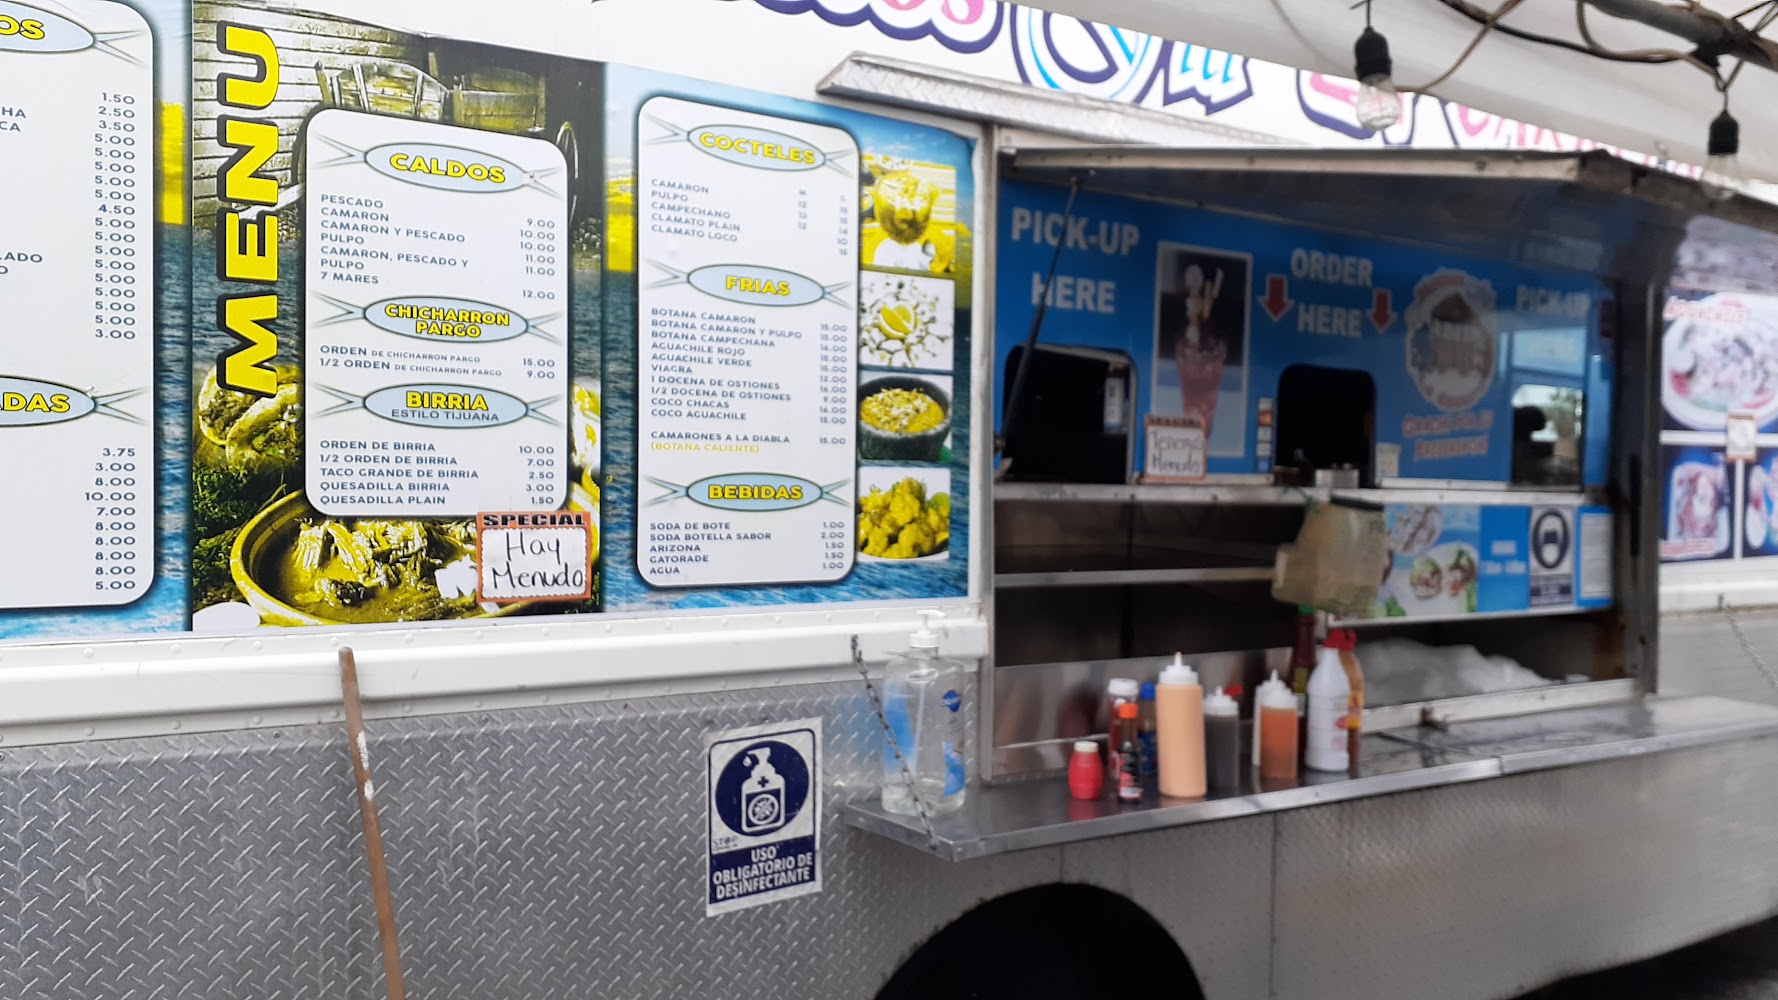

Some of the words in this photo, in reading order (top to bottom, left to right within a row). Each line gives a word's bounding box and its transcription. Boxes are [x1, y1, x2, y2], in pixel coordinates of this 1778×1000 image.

[102, 92, 135, 105] 1.50
[98, 106, 135, 118] 2.50
[98, 120, 135, 132] 3.50
[95, 133, 135, 146] 5.00
[95, 147, 135, 160] 5.00
[699, 132, 815, 165] COCTELES
[95, 161, 135, 174] 5.00
[389, 152, 506, 184] CALDOS
[95, 175, 135, 188] 5.00
[651, 179, 709, 194] CAMARON
[95, 189, 135, 201] 5.00
[651, 190, 688, 202] PULPO
[321, 194, 383, 209] PESCADO
[98, 204, 135, 215] 4.50
[216, 20, 279, 398] MENU
[321, 207, 389, 222] CAMARON
[651, 201, 731, 219] CAMPECHANO
[95, 217, 135, 229] 5.00
[527, 218, 555, 229] 9.00
[651, 213, 705, 227] CLAMATO
[708, 220, 740, 232] PLAIN
[95, 231, 135, 243] 5.00
[321, 220, 389, 235] CAMARON
[394, 227, 401, 236] Y
[406, 229, 465, 242] PESCADO
[520, 229, 555, 241] 10.00
[651, 224, 705, 238] CLAMATO
[708, 232, 738, 242] LOCO
[1010, 207, 1140, 257] PICK-UP
[321, 233, 364, 245] PULPO
[95, 245, 135, 257] 5.00
[520, 241, 555, 252] 10.00
[95, 259, 135, 271] 5.00
[321, 258, 364, 270] PULPO
[397, 253, 457, 266] PESCADO
[461, 259, 468, 268] Y
[525, 254, 555, 264] 11.00
[526, 266, 555, 276] 11.00
[1290, 248, 1373, 288] ORDER
[95, 273, 135, 285] 5.00
[321, 271, 328, 279] 7
[333, 272, 378, 284] MARES
[725, 275, 791, 296] FRIAS
[95, 287, 135, 298] 5.00
[523, 289, 555, 300] 12.00
[1031, 272, 1116, 314] HERE
[95, 301, 135, 312] 5.00
[95, 315, 135, 326] 5.00
[384, 303, 510, 327] CHICHARRON
[651, 308, 697, 319] BOTANA
[701, 312, 756, 324] CAMARON
[1297, 303, 1362, 338] HERE
[95, 329, 136, 340] 3.00
[416, 321, 481, 338] PARGO
[651, 319, 697, 330] BOTANA
[701, 324, 756, 335] CAMARON
[768, 329, 802, 339] PULPO
[651, 330, 697, 341] BOTANA
[700, 335, 775, 347] CAMPECHANA
[320, 345, 367, 356] ORDEN
[651, 342, 713, 353] AGUACHILE
[717, 346, 745, 357] ROJO
[320, 358, 339, 367] 1/2
[344, 359, 390, 370] ORDEN
[523, 358, 555, 368] 15.00
[651, 353, 713, 364] AGUACHILE
[717, 358, 752, 367] VERDE
[527, 370, 555, 379] 9.00
[651, 364, 693, 373] VIAGRA
[658, 376, 705, 385] DOCENA
[709, 379, 723, 387] DE
[727, 380, 780, 390] OSTIONES
[671, 387, 718, 397] DOCENA
[721, 390, 735, 398] DE
[739, 391, 791, 401] OSTIONES
[406, 391, 489, 412] BIRRIA
[651, 397, 683, 406] COCO
[686, 399, 730, 409] CHACAS
[391, 409, 439, 419] ESTILO
[444, 411, 499, 421] TIJUANA
[651, 408, 683, 417] COCO
[686, 410, 746, 420] AGUACHILE
[651, 431, 722, 441] CAMARONES
[752, 435, 790, 443] DIABLA
[320, 440, 367, 449] ORDEN
[372, 441, 389, 450] DE
[393, 442, 435, 451] BIRRIA
[519, 446, 554, 454] 10.00
[103, 447, 135, 457] 3.75
[320, 454, 339, 463] 1/2
[344, 455, 390, 464] ORDEN
[395, 456, 411, 464] DE
[416, 456, 457, 465] BIRRIA
[527, 458, 554, 467] 7.00
[95, 462, 135, 472] 3.00
[320, 468, 354, 476] TACO
[358, 468, 412, 477] GRANDE
[417, 469, 433, 478] DE
[438, 470, 478, 478] BIRRIA
[529, 471, 554, 479] 2.50
[95, 477, 135, 486] 8.00
[320, 482, 404, 491] QUESADILLA
[408, 483, 450, 491] BIRRIA
[526, 484, 554, 492] 3.00
[708, 484, 804, 500] BEBIDAS
[85, 492, 136, 501] 10.00
[320, 495, 404, 505] QUESADILLA
[408, 496, 445, 504] PLAIN
[531, 496, 554, 505] 1.50
[97, 507, 136, 516] 7.00
[483, 514, 585, 526] SPECIAL
[702, 522, 730, 530] BOTE
[95, 522, 136, 531] 8.00
[95, 536, 136, 546] 8.00
[684, 533, 732, 541] BOTELLA
[506, 531, 561, 565] Hay
[650, 544, 701, 552] ARIZONA
[95, 551, 136, 560] 8.00
[649, 555, 709, 564] GATORADE
[95, 566, 136, 575] 8.00
[492, 561, 583, 589] Menudo
[649, 567, 680, 575] AGUA
[95, 580, 136, 590] 5.00
[751, 845, 777, 863] USO
[712, 855, 796, 885] OBLIGATORIO
[797, 852, 813, 866] DE
[715, 867, 810, 899] DESINFECTANTE
